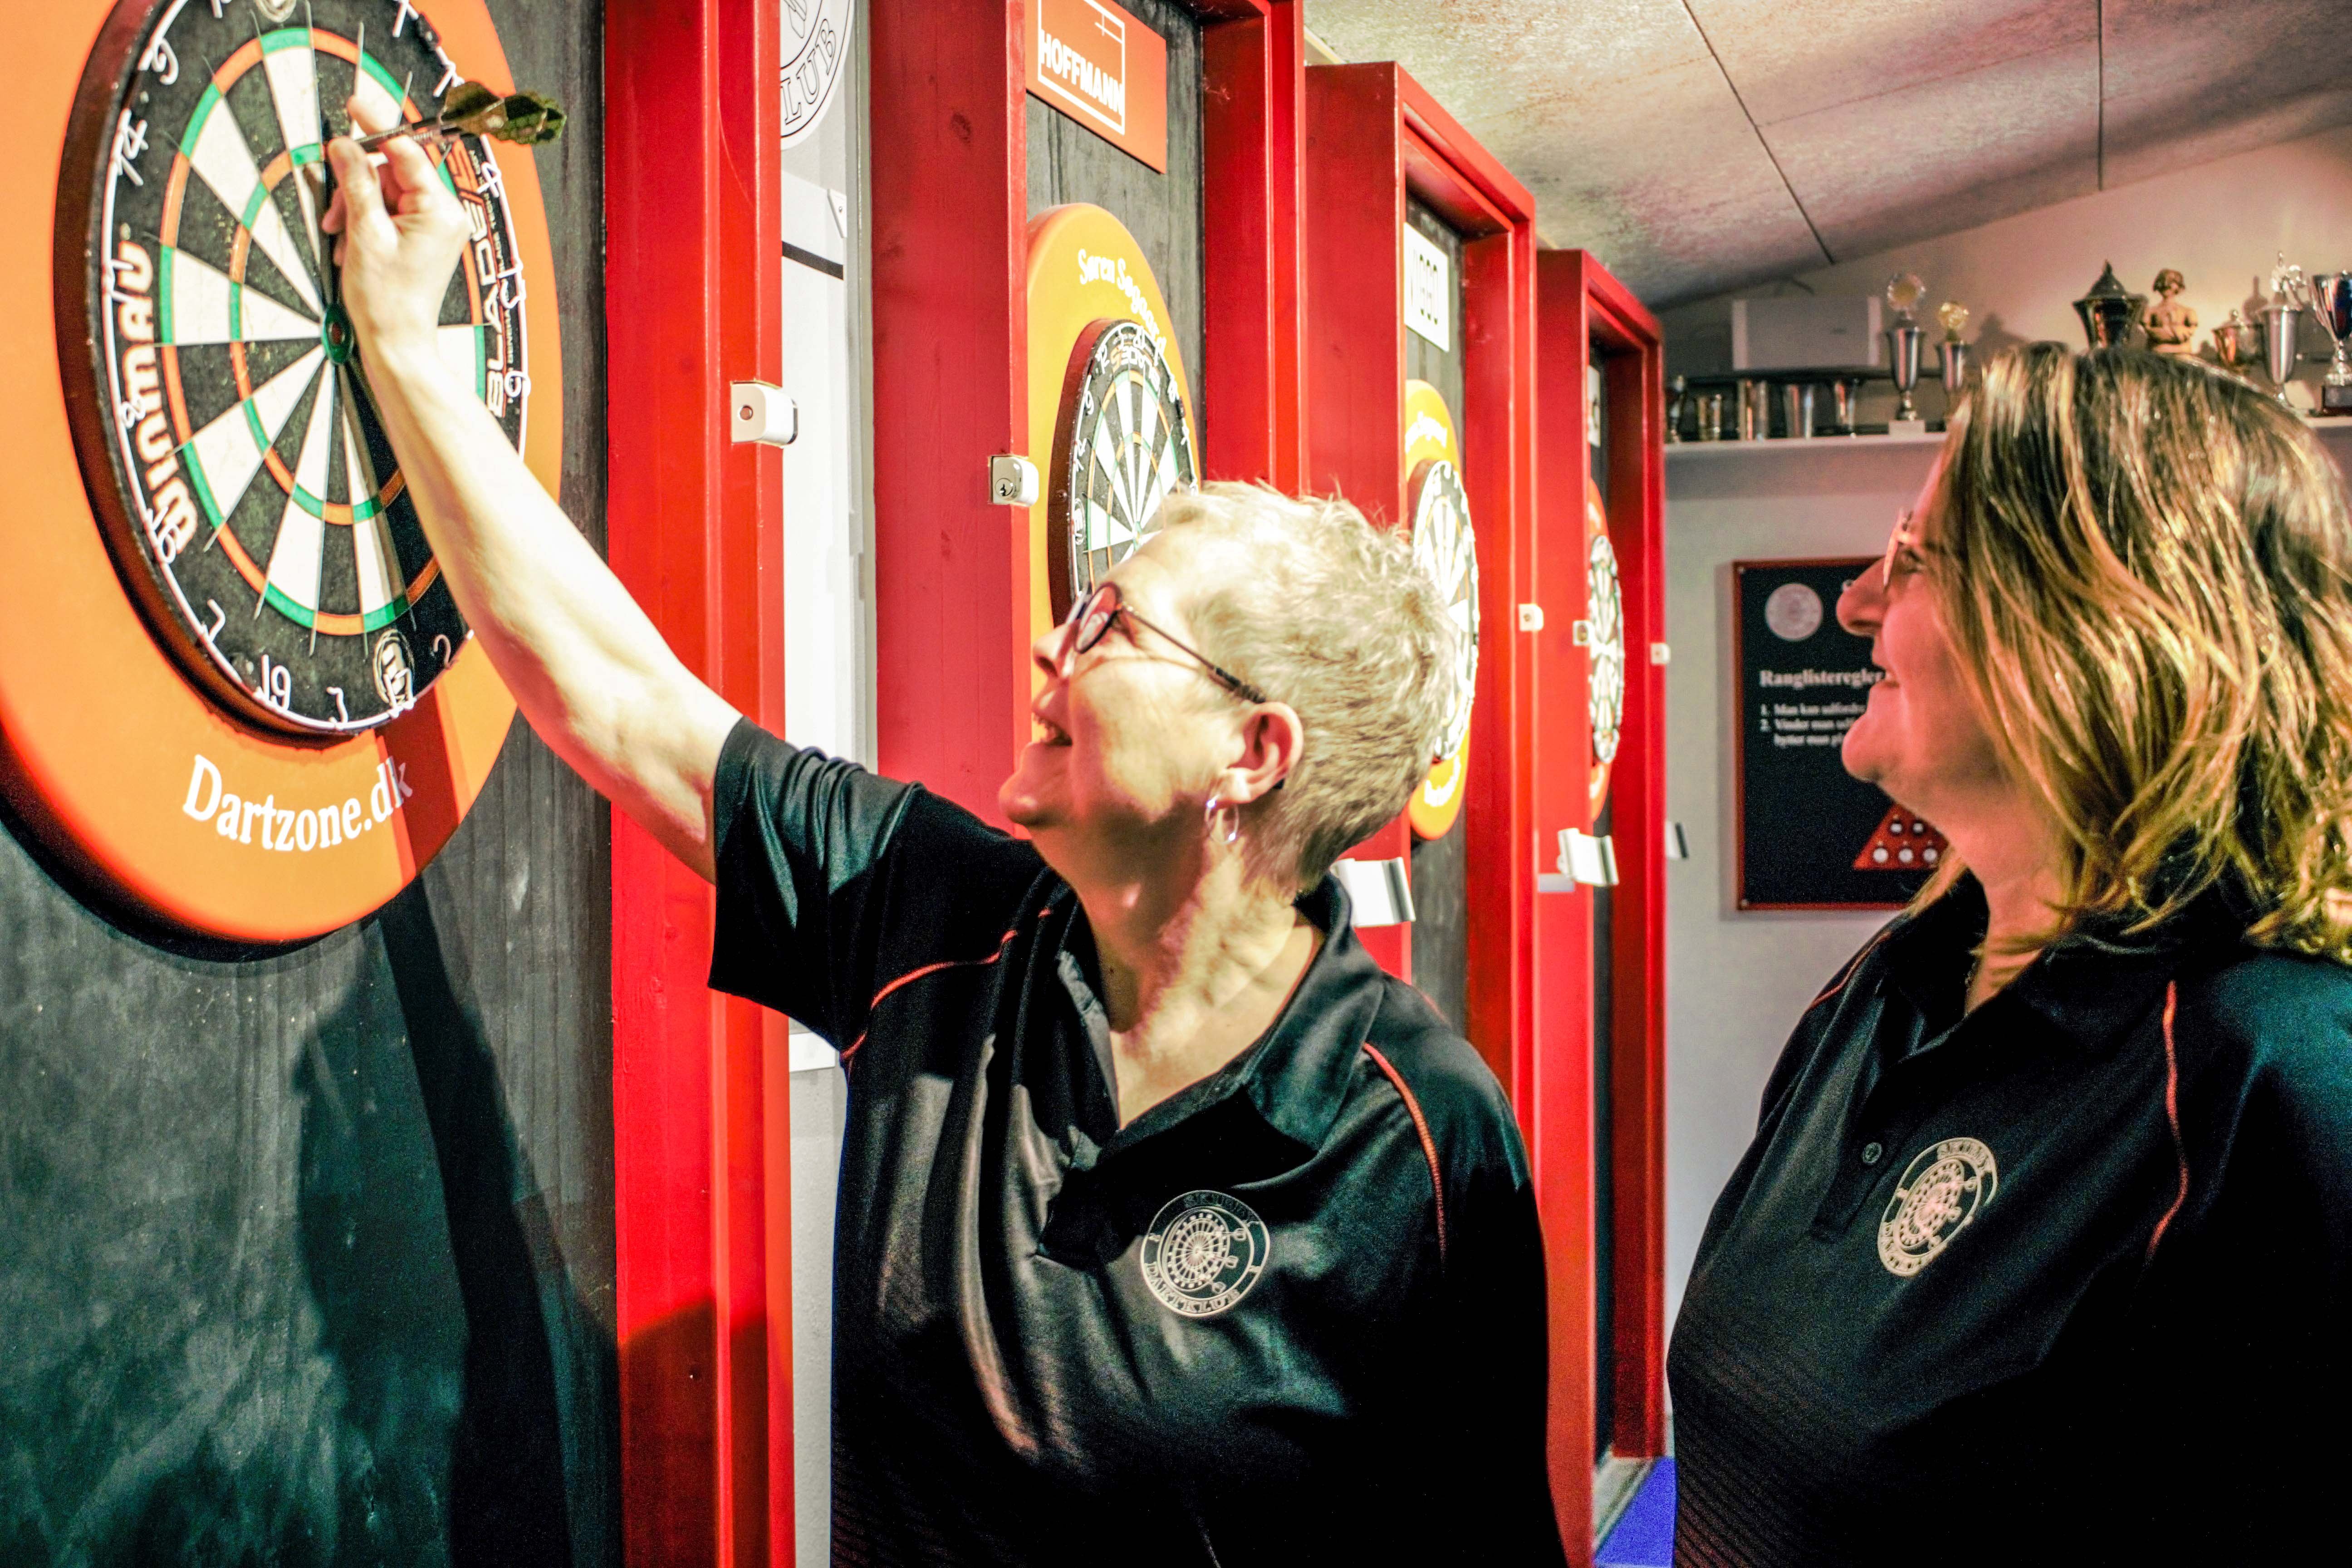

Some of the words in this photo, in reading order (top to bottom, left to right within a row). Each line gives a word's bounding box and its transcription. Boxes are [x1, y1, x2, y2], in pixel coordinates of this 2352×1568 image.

[1039, 29, 1125, 117] HOFFMANN
[463, 199, 504, 417] BLADE
[182, 754, 413, 851] Dartzone.dk
